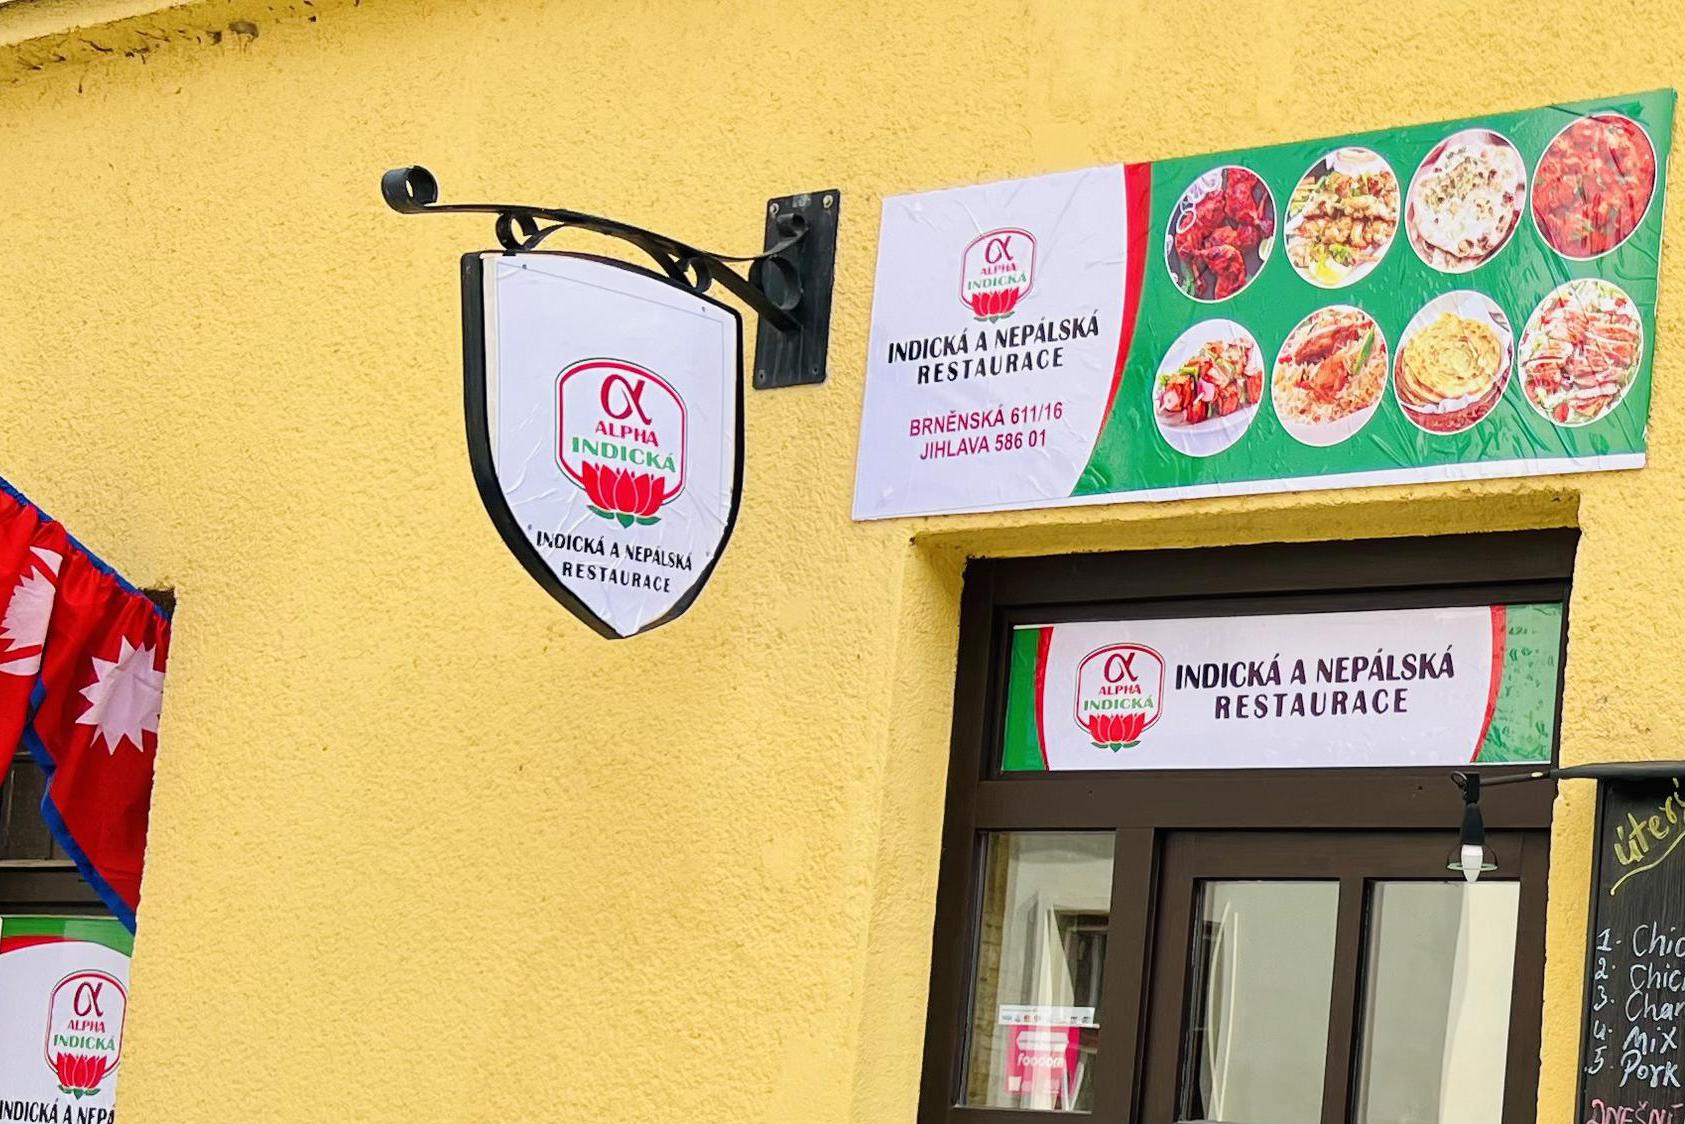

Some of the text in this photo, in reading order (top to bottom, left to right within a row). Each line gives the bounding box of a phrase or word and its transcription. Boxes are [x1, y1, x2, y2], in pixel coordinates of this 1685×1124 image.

[968, 272, 1027, 290] INDICKÁ
[980, 263, 1017, 275] ALPHA
[888, 309, 1099, 364] INDICKÁ A NEPÁLSKÁ
[917, 347, 1064, 385] RESTAURACE
[595, 420, 659, 447] ALPHA
[909, 402, 1063, 437] BRNĚNSKÁ 611/16
[571, 437, 677, 473] INDICKÁ
[920, 429, 1047, 460] JIHLAVA 586 01
[536, 529, 692, 571] INDICKÁ A NEPÁLSKÁ
[562, 561, 672, 593] RESTAURACE
[1175, 644, 1456, 690] INDICKÁ A NEPÁLSKÁ
[1083, 693, 1154, 712] INDICKÁ
[1098, 682, 1141, 696] ALPHA
[1214, 687, 1408, 720] RESTAURACE
[53, 1034, 116, 1051] INDICKÁ
[67, 1019, 106, 1034] ALPHA
[1619, 1049, 1681, 1088] Pork
